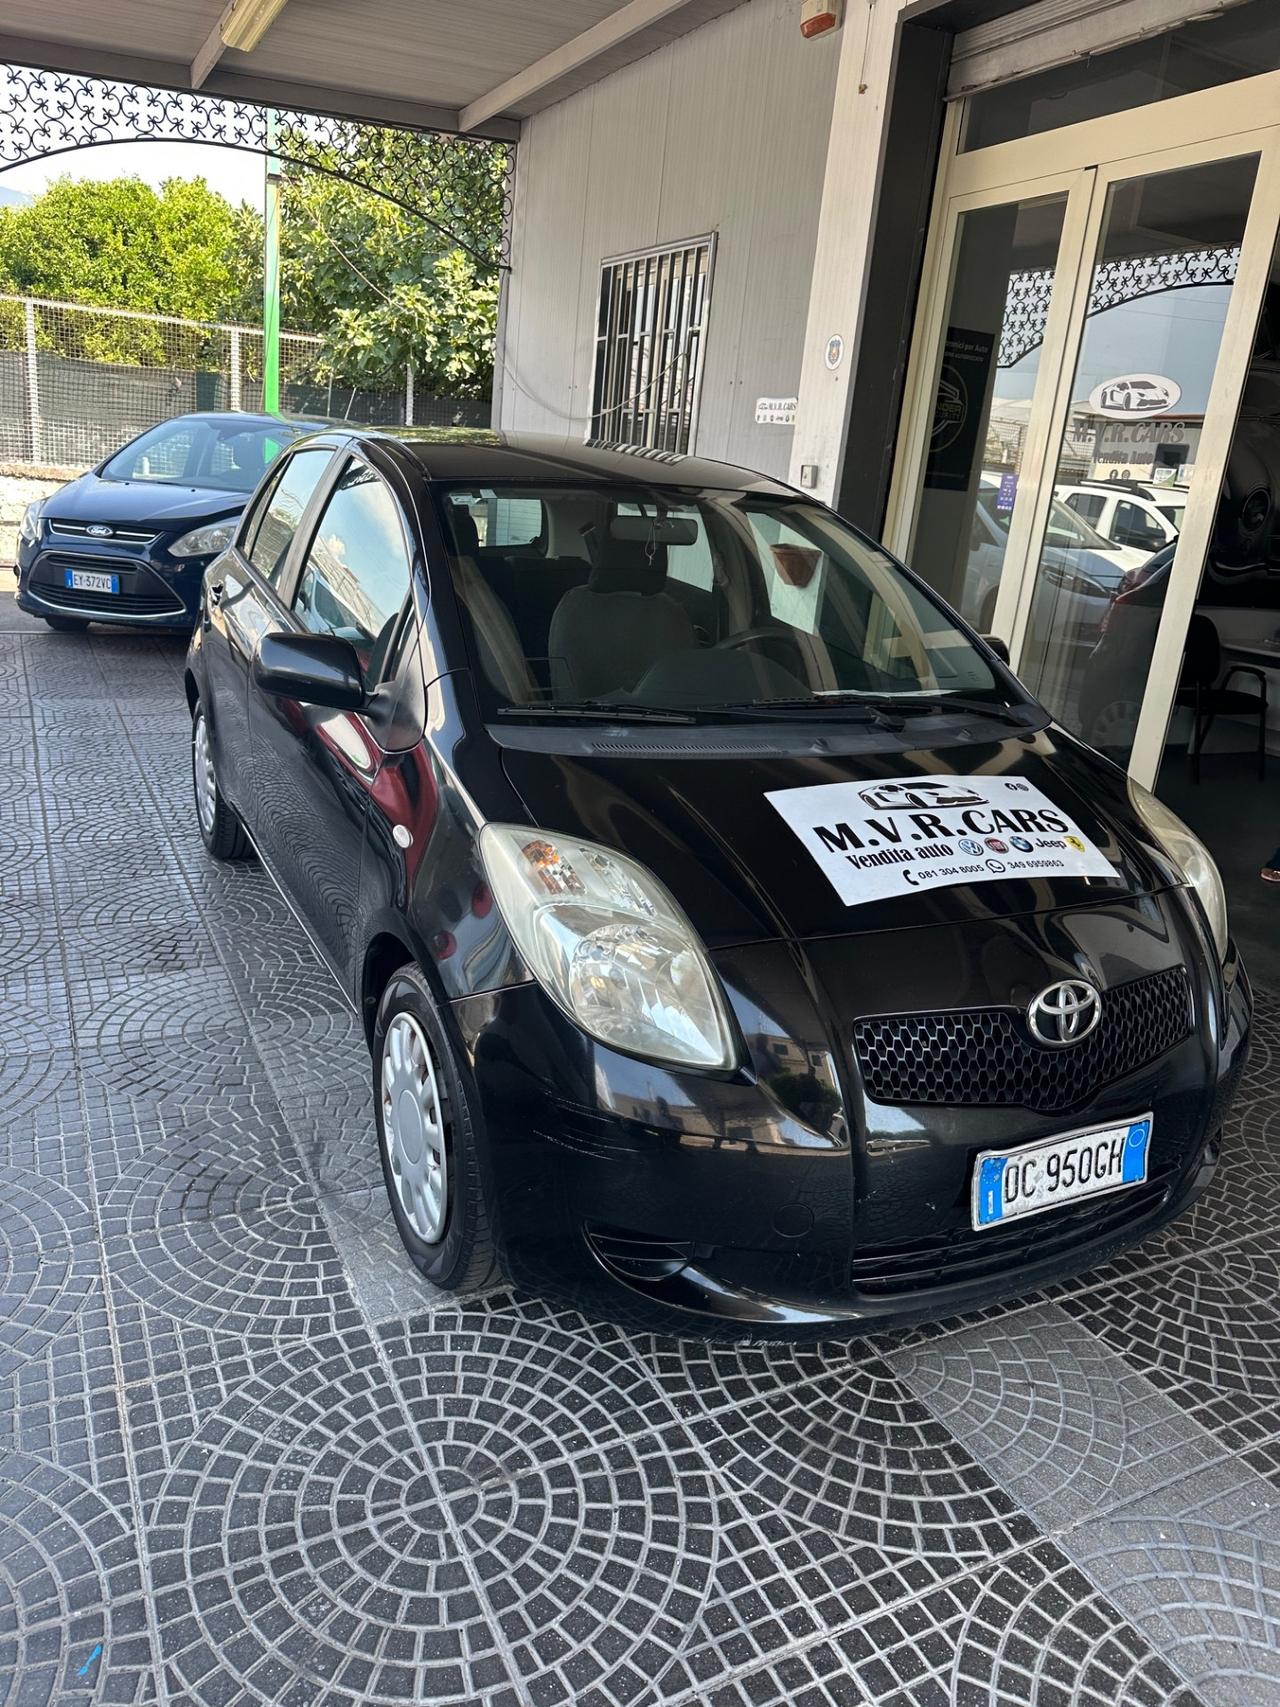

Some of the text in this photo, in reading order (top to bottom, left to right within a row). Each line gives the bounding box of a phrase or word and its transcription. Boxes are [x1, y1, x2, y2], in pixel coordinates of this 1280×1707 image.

[1072, 418, 1185, 443] M.V.R.CARS
[86, 575, 112, 590] 372VC
[812, 809, 1069, 853] M.V.R.CARS
[1035, 838, 1067, 849] Jeep
[845, 842, 954, 870] Vendita auto
[1007, 860, 1026, 869] 349
[917, 864, 985, 880] 081 304 8005
[1004, 1160, 1037, 1203] DC
[1046, 1137, 1125, 1192] 950GH
